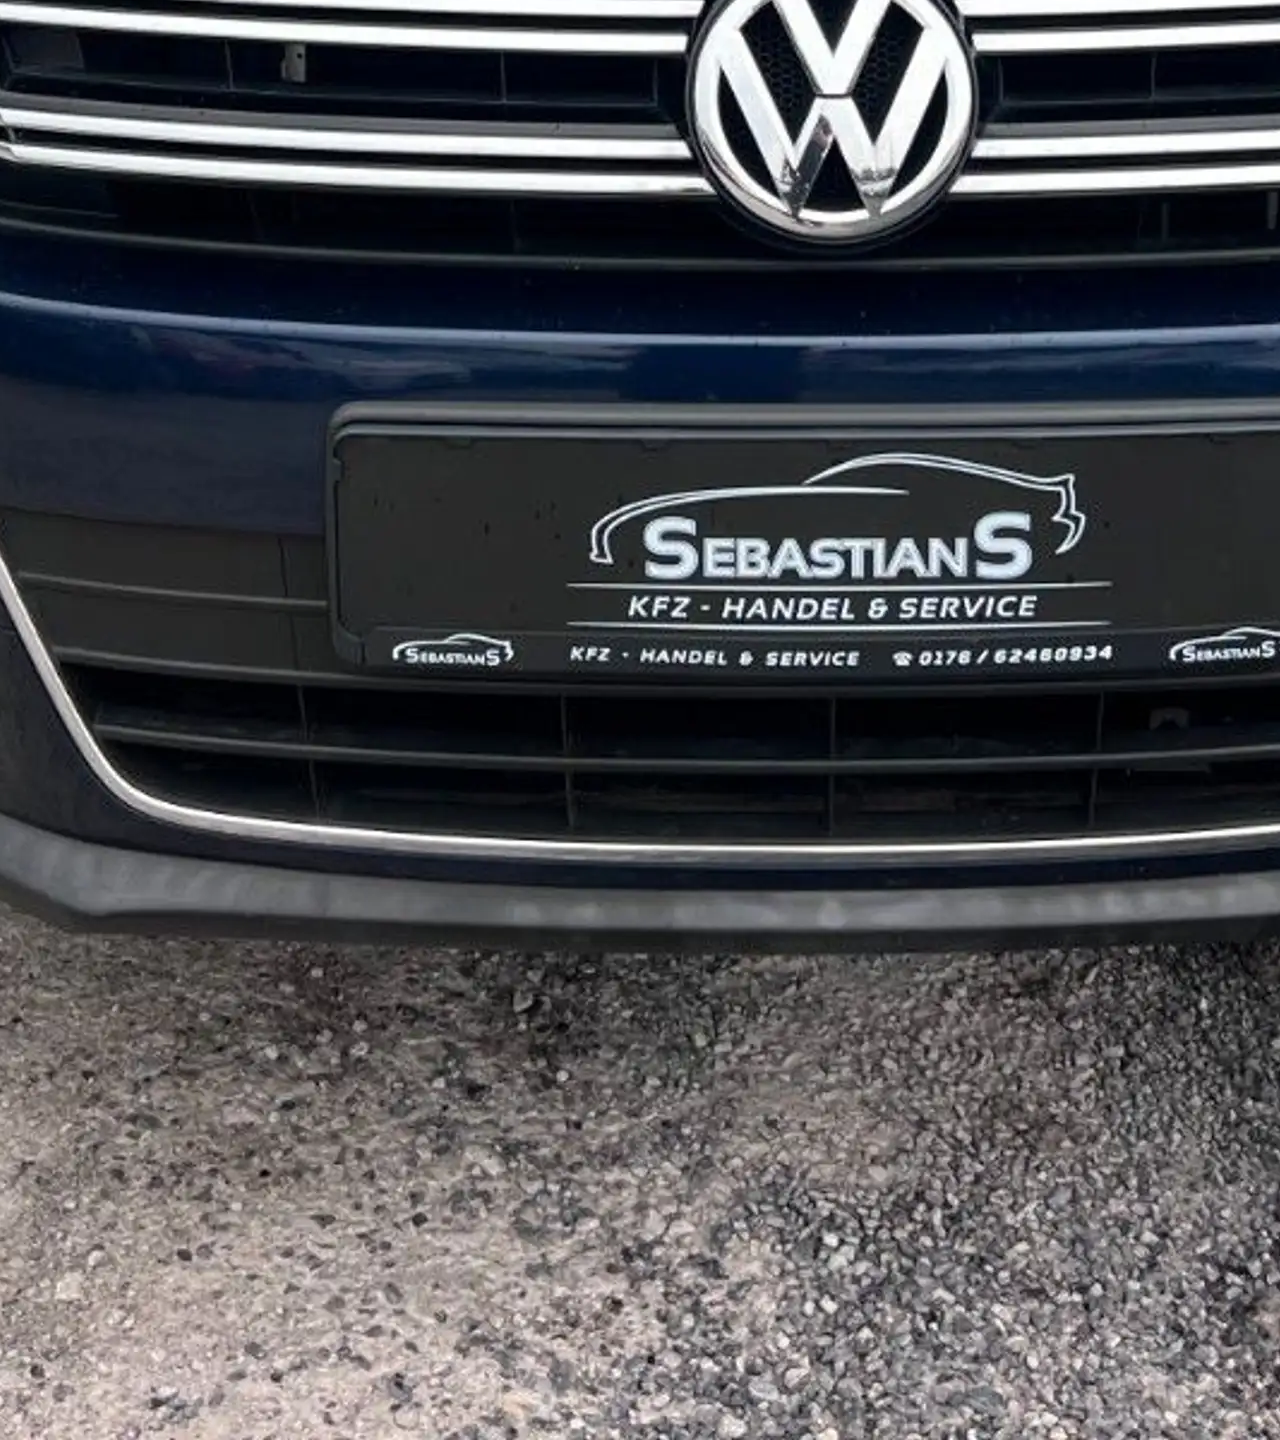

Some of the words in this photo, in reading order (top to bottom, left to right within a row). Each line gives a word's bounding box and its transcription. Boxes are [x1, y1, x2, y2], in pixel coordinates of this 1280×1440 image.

[641, 510, 1034, 581] SEBASTIANS
[627, 595, 692, 620] KFZ
[721, 596, 856, 621] HANDEL
[867, 596, 889, 620] &
[898, 594, 1038, 620] SERVICE
[569, 645, 611, 663] KFZ
[639, 647, 728, 667] HANDEL
[738, 650, 754, 667] &
[765, 650, 860, 668] SERVICE
